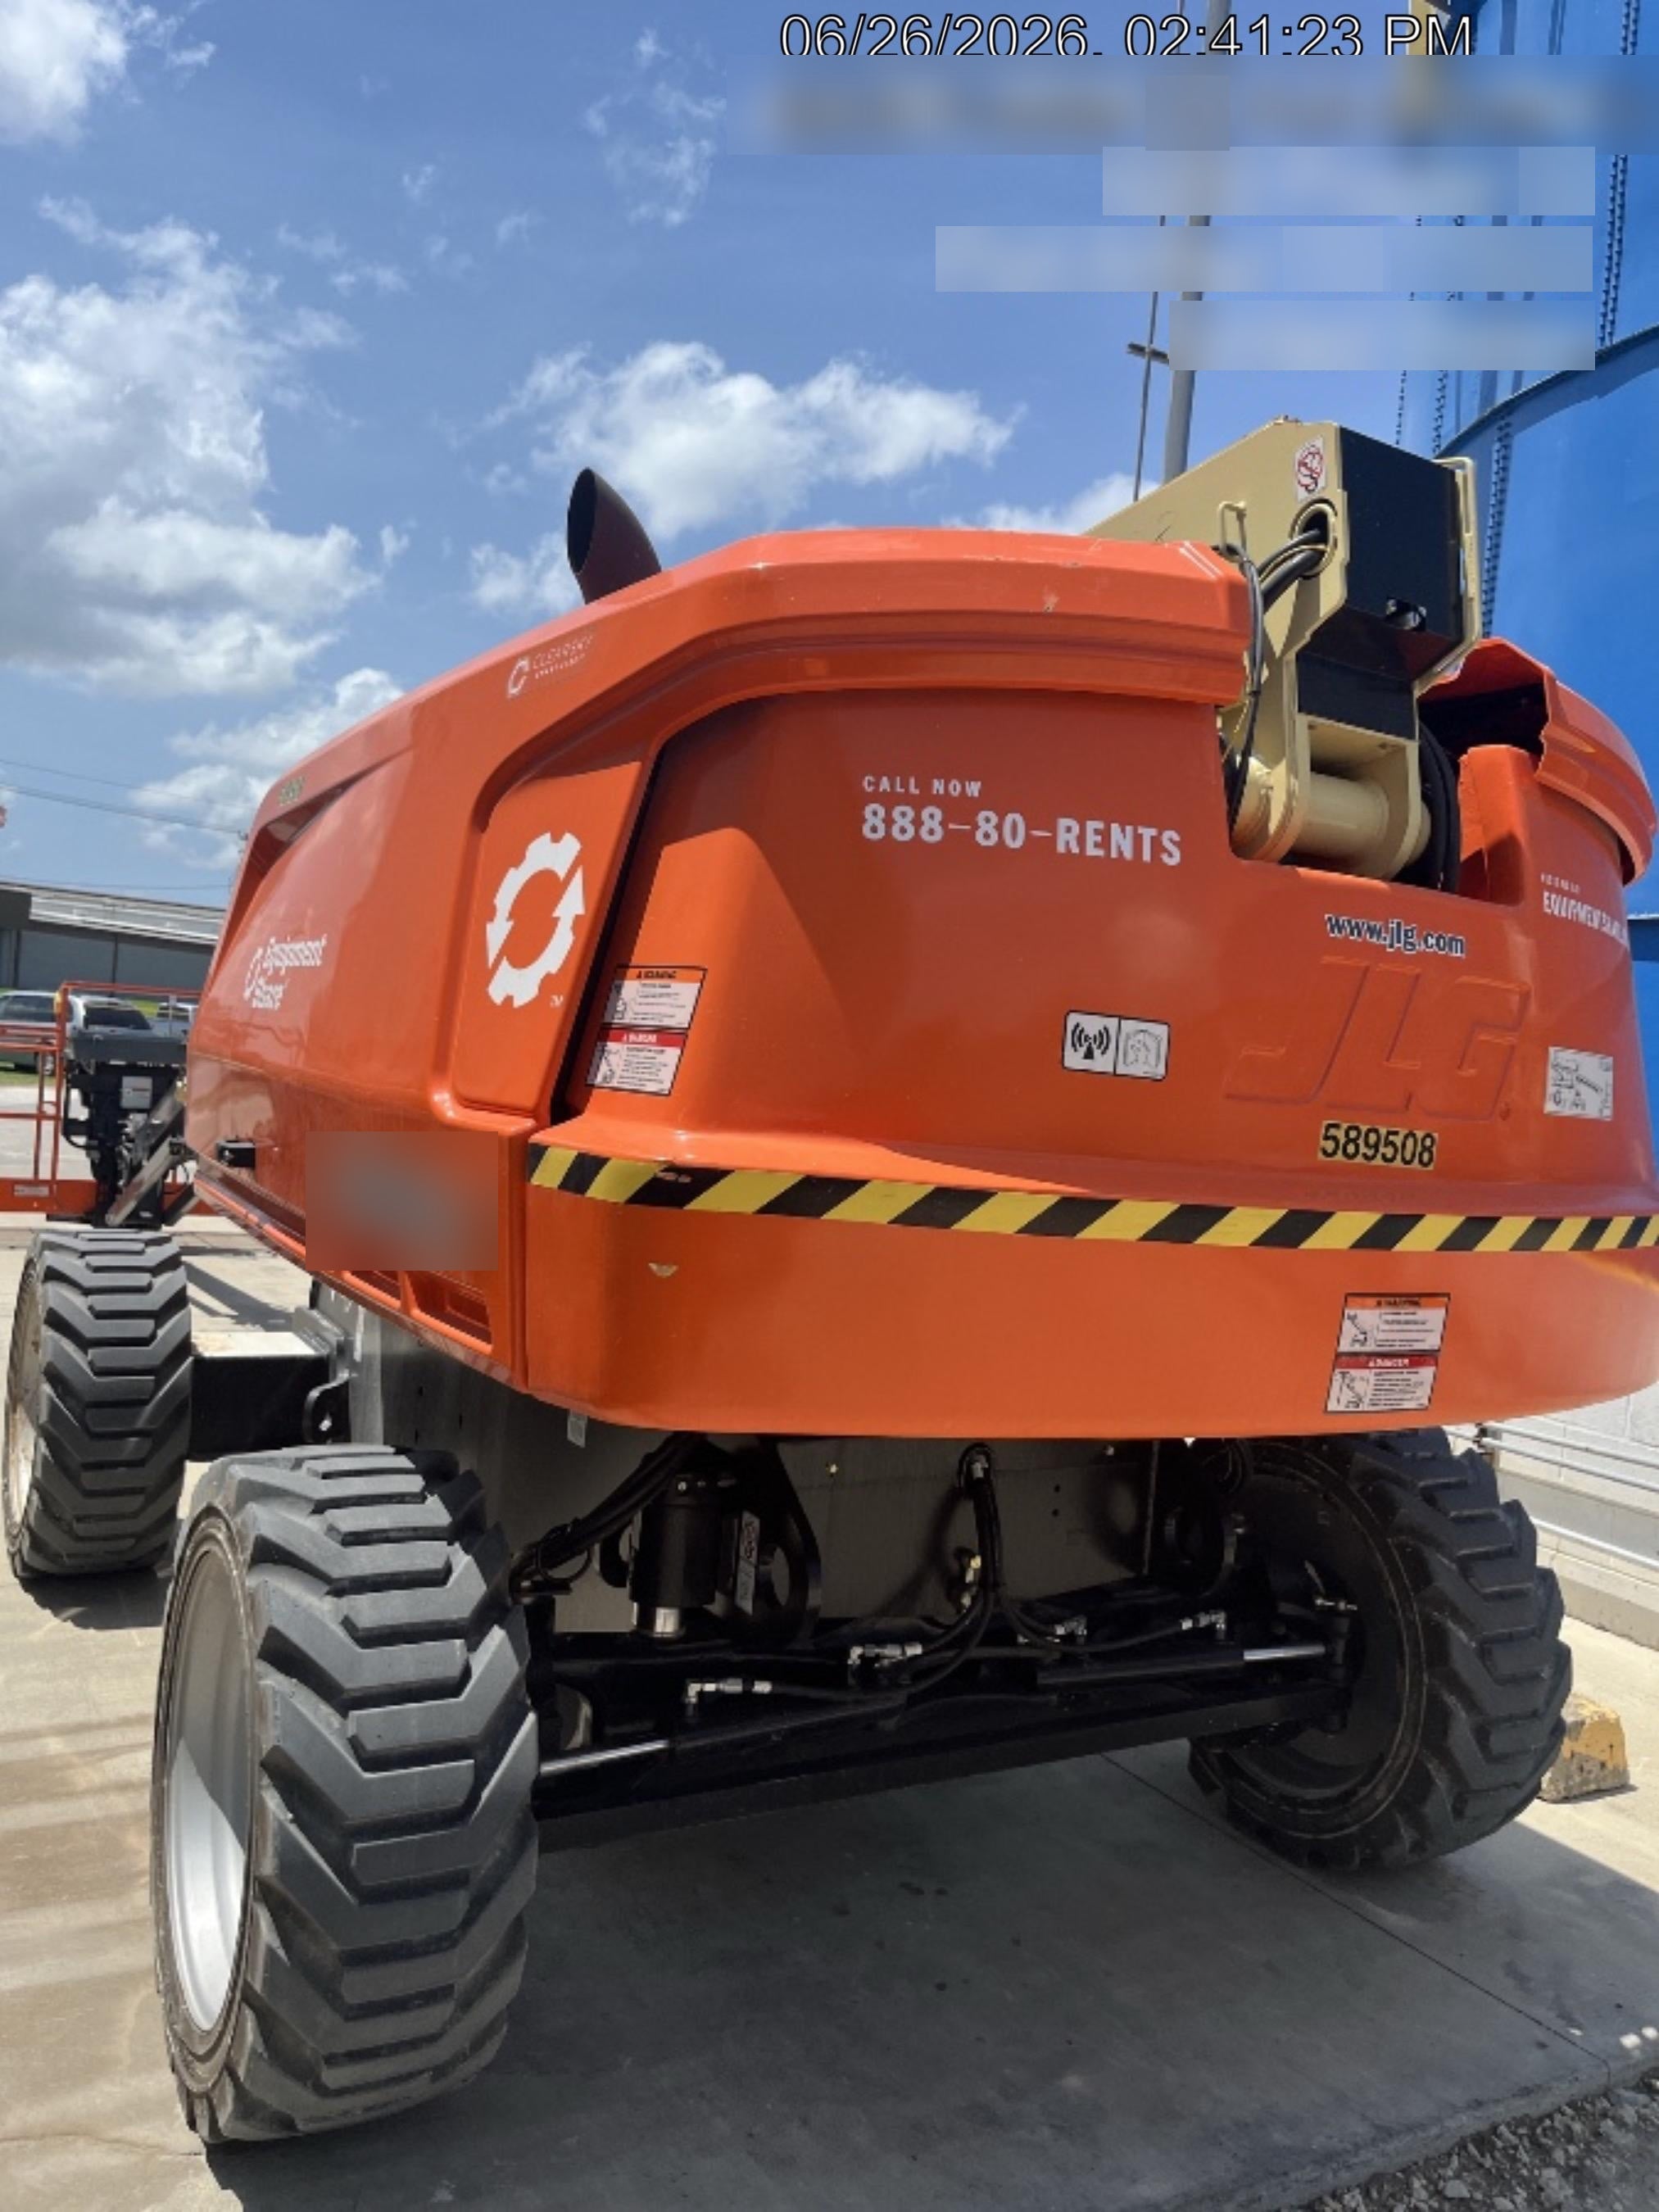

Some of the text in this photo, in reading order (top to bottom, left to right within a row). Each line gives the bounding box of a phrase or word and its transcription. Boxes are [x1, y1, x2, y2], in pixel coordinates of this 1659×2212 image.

[863, 774, 982, 798] CALL NOW
[862, 803, 1181, 867] 888-80-RENTS
[1324, 913, 1466, 958] www.jlg.com
[1225, 955, 1532, 1122] JLG
[1320, 1122, 1437, 1168] 589508
